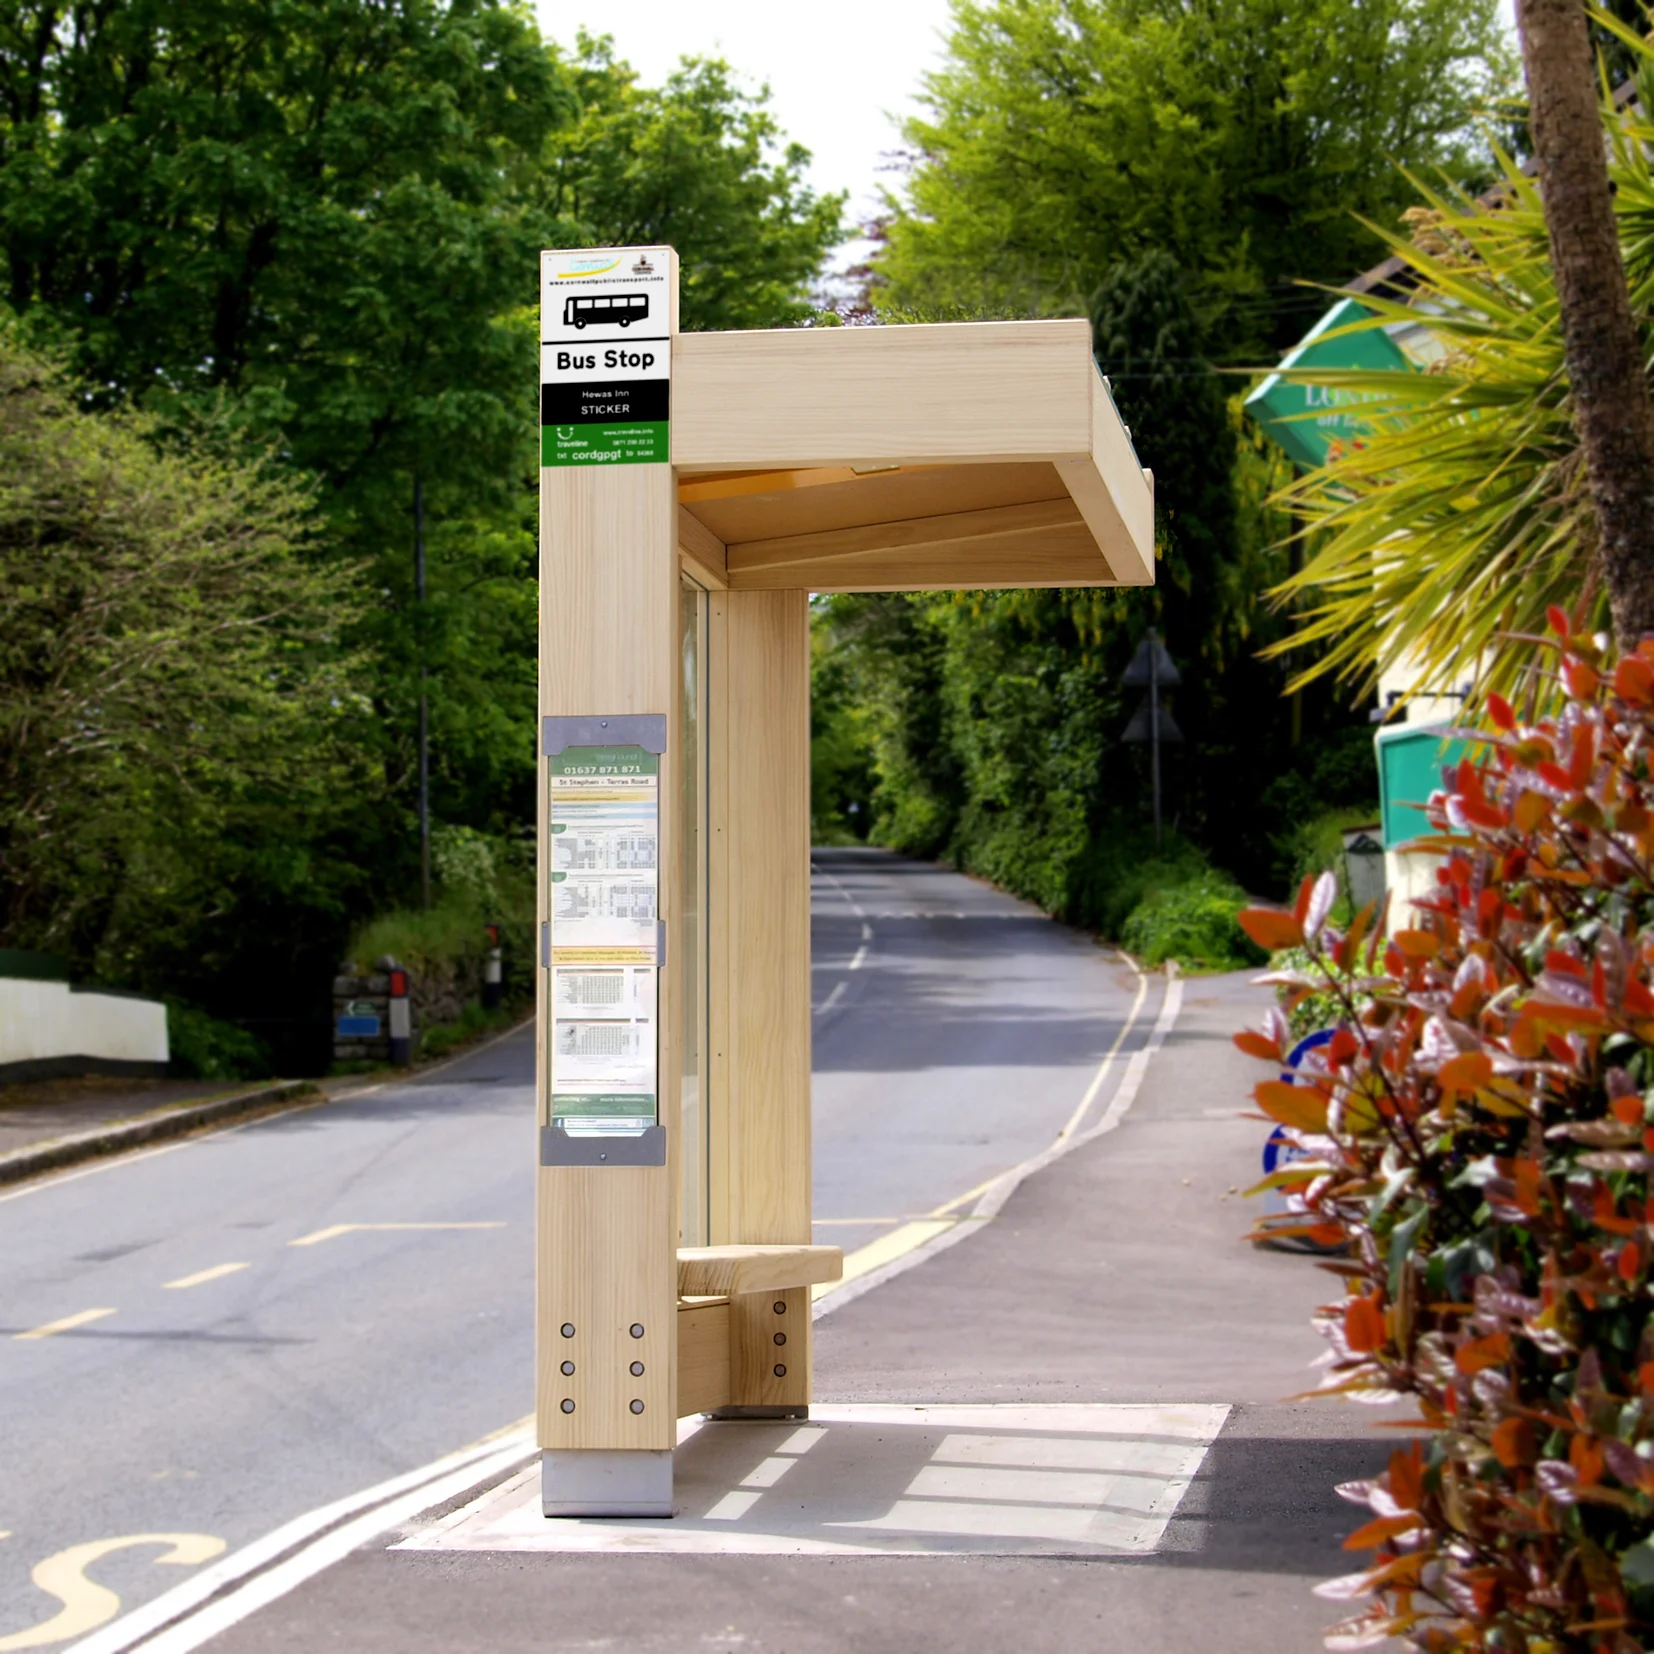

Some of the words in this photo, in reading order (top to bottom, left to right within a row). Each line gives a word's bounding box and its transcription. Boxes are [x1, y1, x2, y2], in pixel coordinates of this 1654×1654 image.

[557, 352, 596, 370] Bus
[604, 350, 655, 370] Stop
[582, 391, 612, 399] Hewas
[581, 404, 630, 415] STICKER
[557, 440, 588, 448] traveline
[572, 450, 622, 462] cordgpgt
[564, 766, 597, 775] 01637
[599, 765, 619, 774] 871
[621, 765, 641, 774] 871
[569, 778, 599, 787] Stephen
